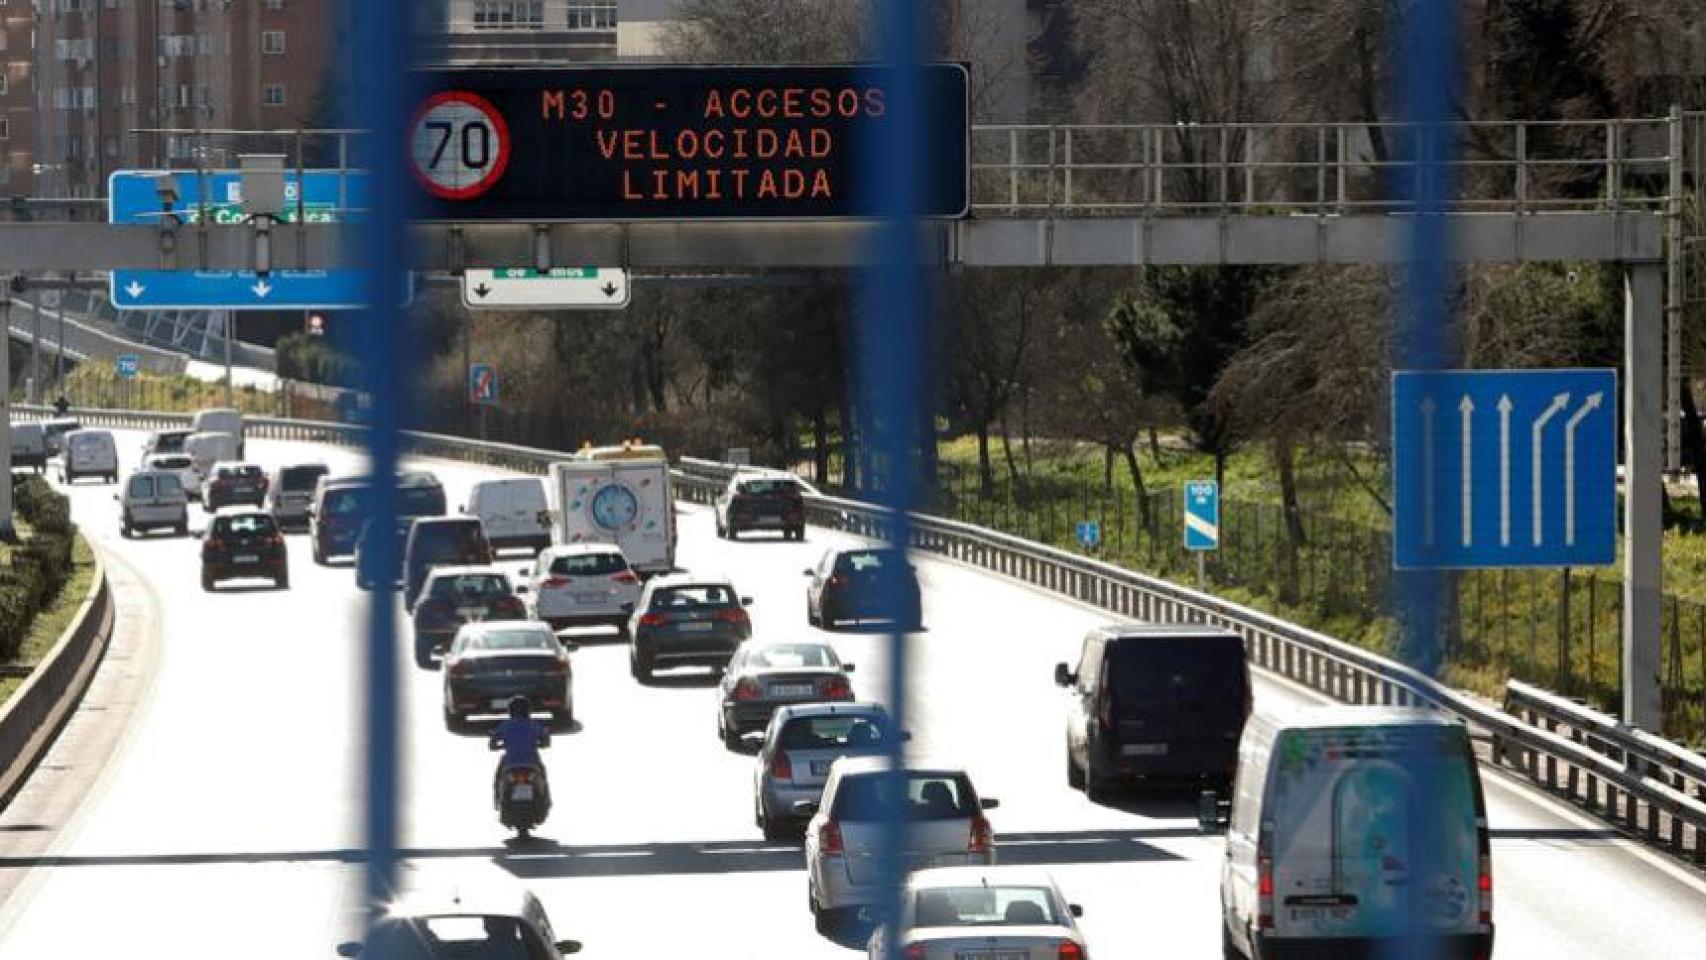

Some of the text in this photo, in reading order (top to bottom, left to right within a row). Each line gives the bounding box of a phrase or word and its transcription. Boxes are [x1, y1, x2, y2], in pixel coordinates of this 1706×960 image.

[542, 89, 615, 119] M30
[704, 89, 886, 118] ACCESOS
[425, 120, 490, 169] 70
[597, 129, 833, 159] VELOCIDAD
[623, 169, 833, 200] LIMITADA
